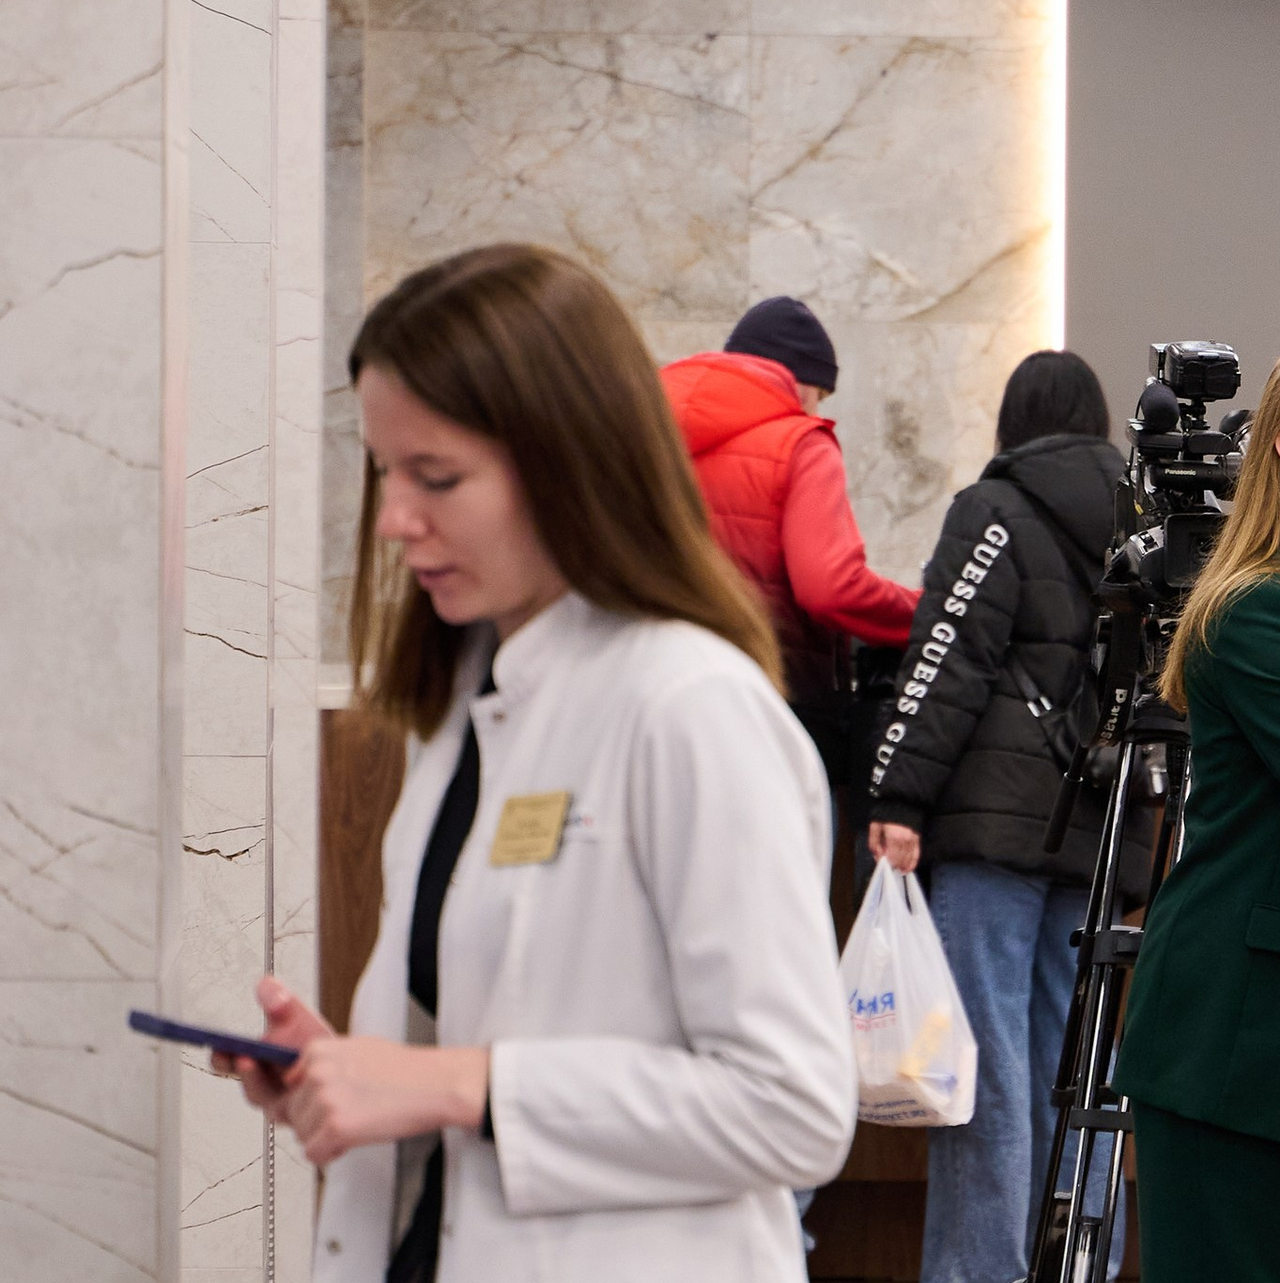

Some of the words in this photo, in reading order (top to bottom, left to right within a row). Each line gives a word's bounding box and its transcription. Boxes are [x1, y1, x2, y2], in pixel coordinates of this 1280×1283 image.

[1165, 468, 1196, 476] Panasonic
[943, 523, 1010, 617] GUESS
[897, 621, 957, 716] GUESS
[869, 721, 907, 798] GUE
